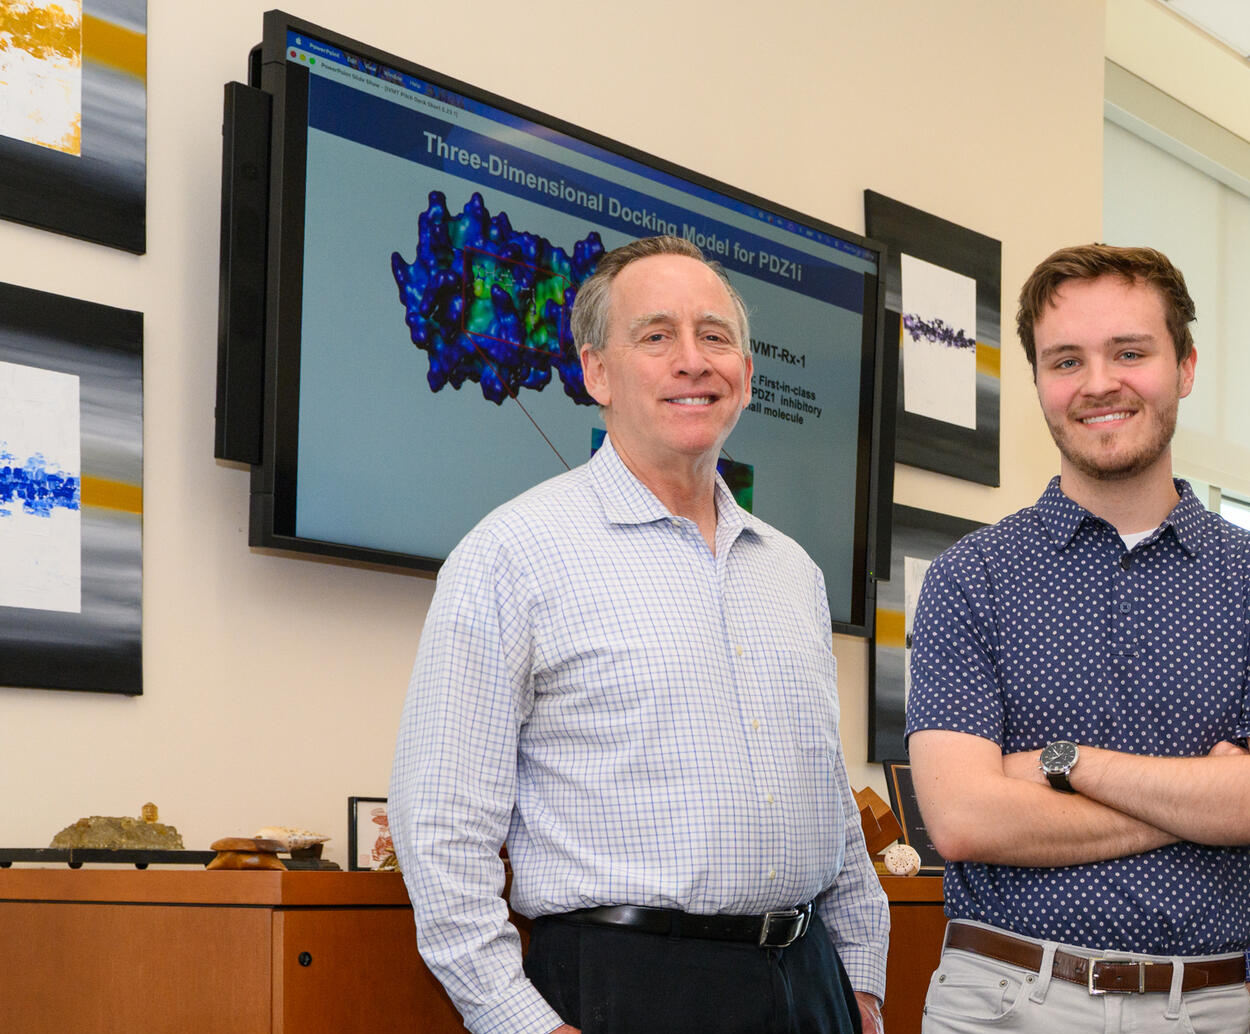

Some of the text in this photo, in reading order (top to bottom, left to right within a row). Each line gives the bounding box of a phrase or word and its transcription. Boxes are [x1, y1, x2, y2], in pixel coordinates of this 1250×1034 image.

[423, 130, 802, 281] Three-Dimensional Docking Model for PDZ1i
[759, 375, 816, 400] First-in-class
[764, 407, 804, 425] molecule
[781, 395, 822, 418] inhibitory
